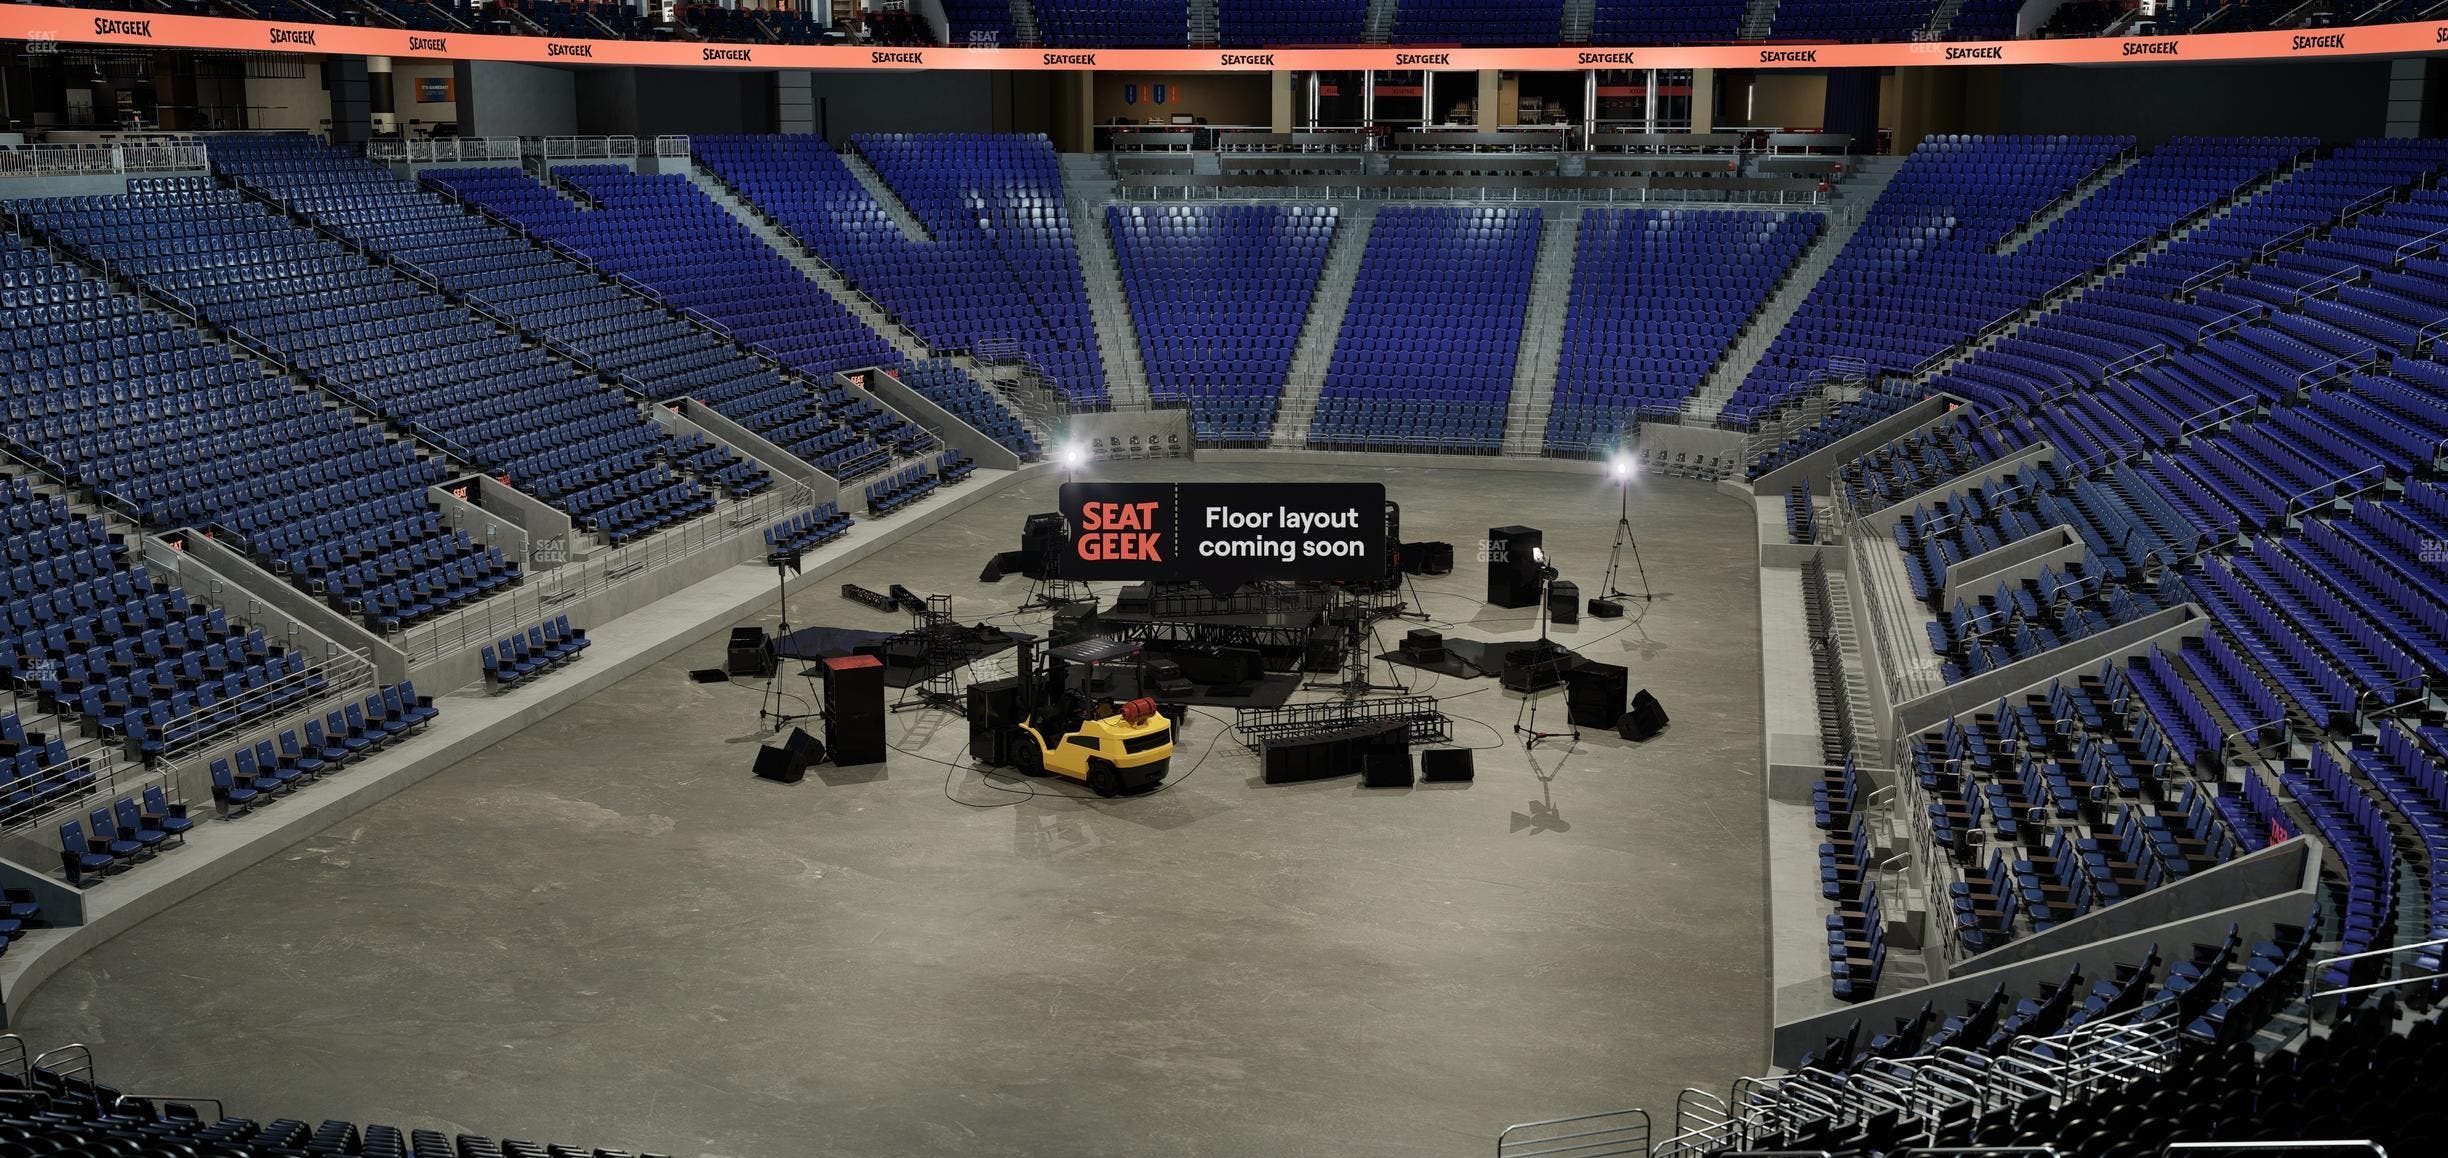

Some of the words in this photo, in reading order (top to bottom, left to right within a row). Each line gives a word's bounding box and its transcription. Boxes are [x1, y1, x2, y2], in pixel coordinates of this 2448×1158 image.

[94, 17, 152, 38] SEATGEEK
[269, 27, 316, 46] SEATGEEK
[2292, 33, 2345, 51] SEATGEEK
[409, 36, 447, 53] SEATGEEK
[547, 42, 593, 58] SEATGEEK
[2122, 40, 2179, 57] SEATGEEK
[702, 47, 752, 62] SEATGEEK
[871, 51, 923, 65] SEATGEEK
[1043, 53, 1096, 66] SEATGEEK
[1221, 54, 1275, 66] SEATGEEK
[1395, 53, 1450, 66] SEATGEEK
[1578, 51, 1634, 65] SEATGEEK
[1759, 50, 1817, 63] SEATGEEK
[1945, 46, 2003, 60] SEATGEEK
